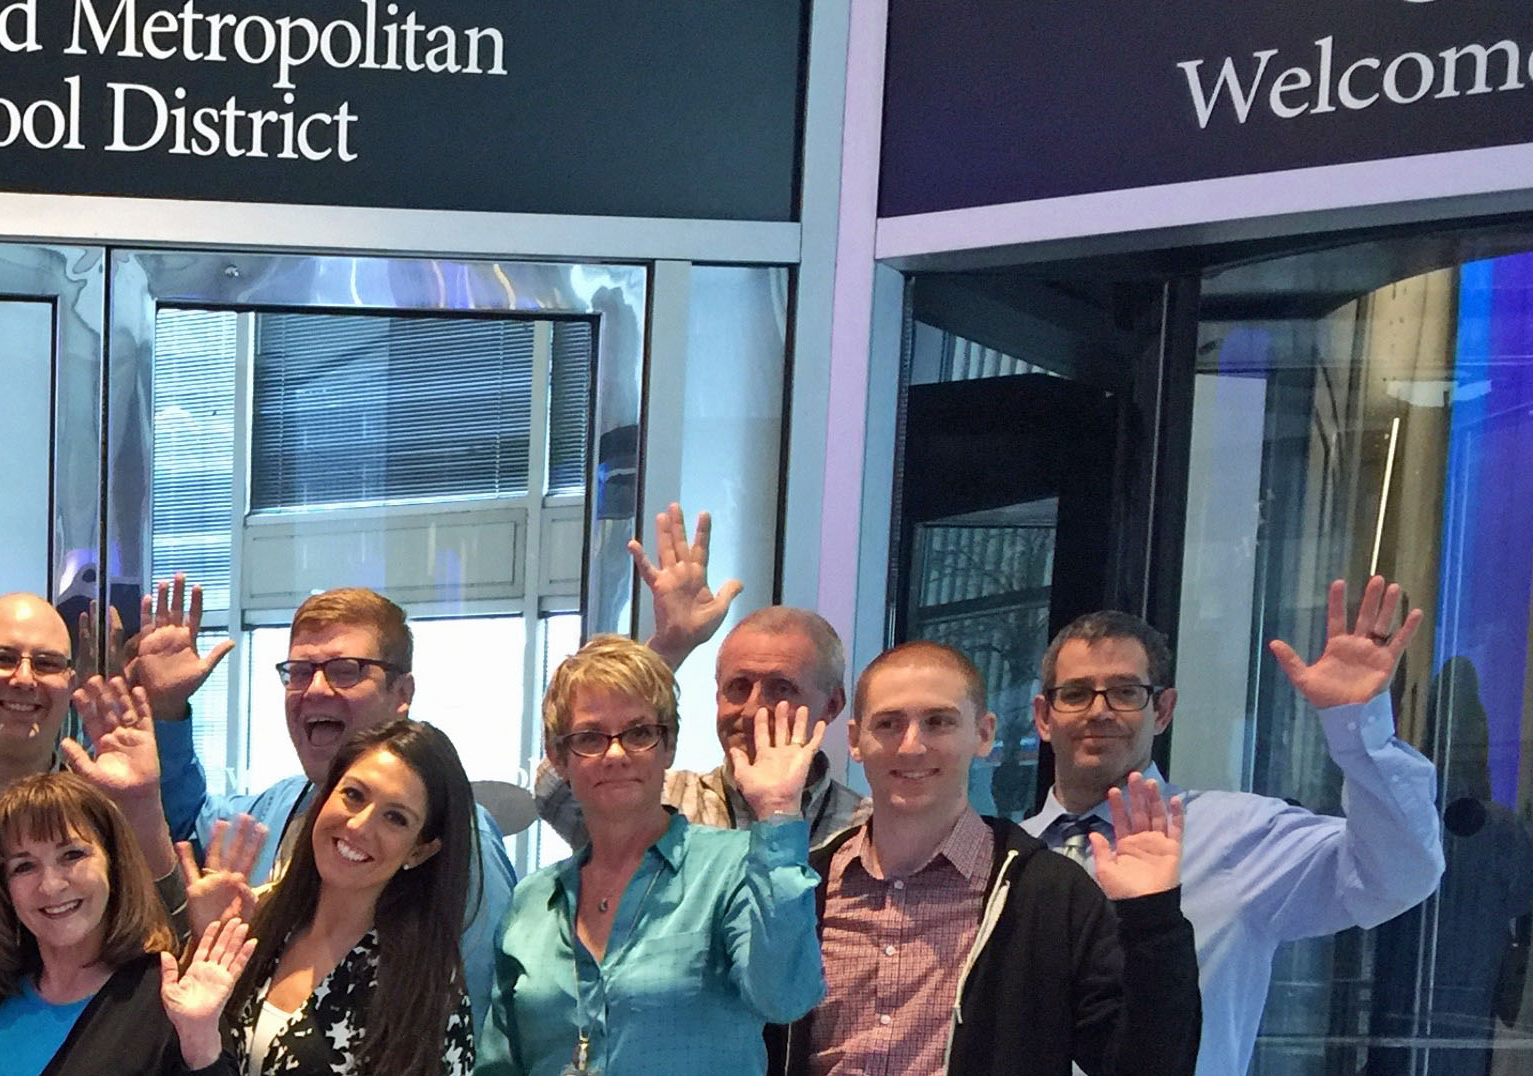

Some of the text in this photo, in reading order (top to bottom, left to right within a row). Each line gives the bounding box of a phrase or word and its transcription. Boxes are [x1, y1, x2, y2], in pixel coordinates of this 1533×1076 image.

[63, 0, 508, 90] Metropolitan
[1176, 35, 1533, 129] Welcom
[103, 82, 359, 162] District
